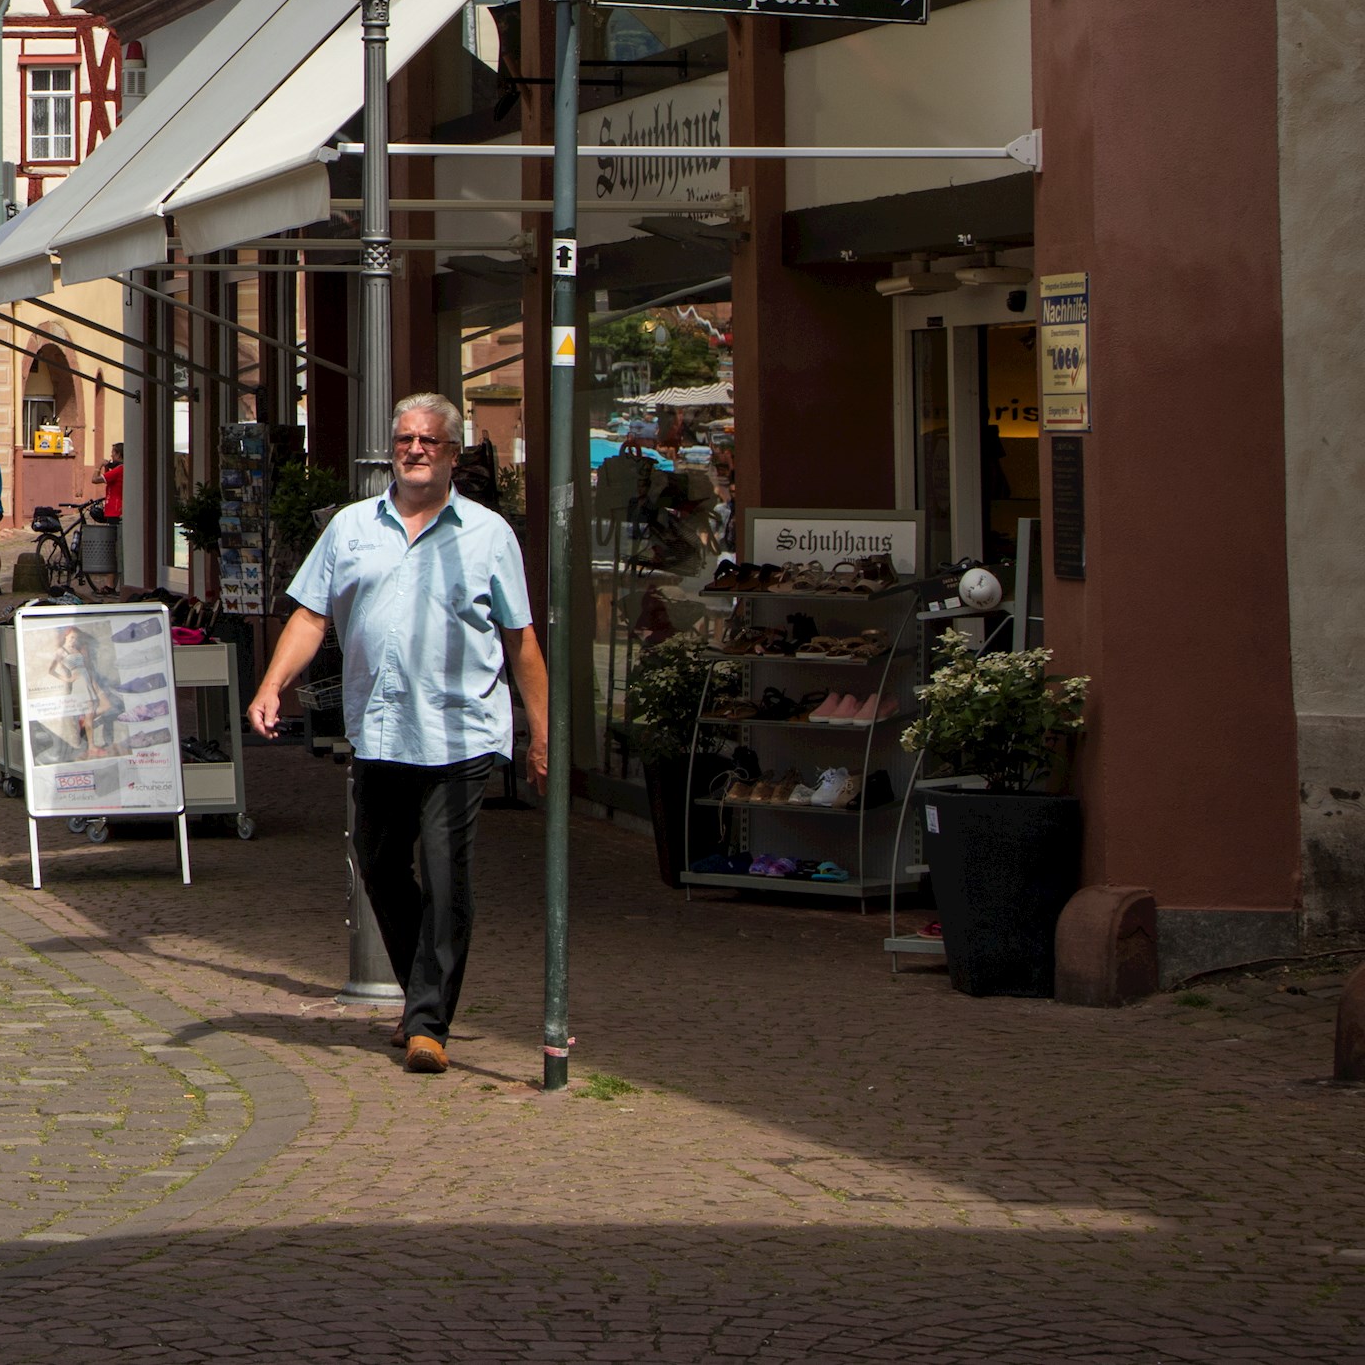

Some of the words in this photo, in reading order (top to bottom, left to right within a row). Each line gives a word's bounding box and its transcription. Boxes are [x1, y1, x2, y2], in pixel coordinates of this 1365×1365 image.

[596, 98, 722, 201] Schuhhaus
[1042, 297, 1088, 324] Nachhilfe
[776, 527, 894, 555] Schuhhaus
[58, 775, 92, 787] BOBS
